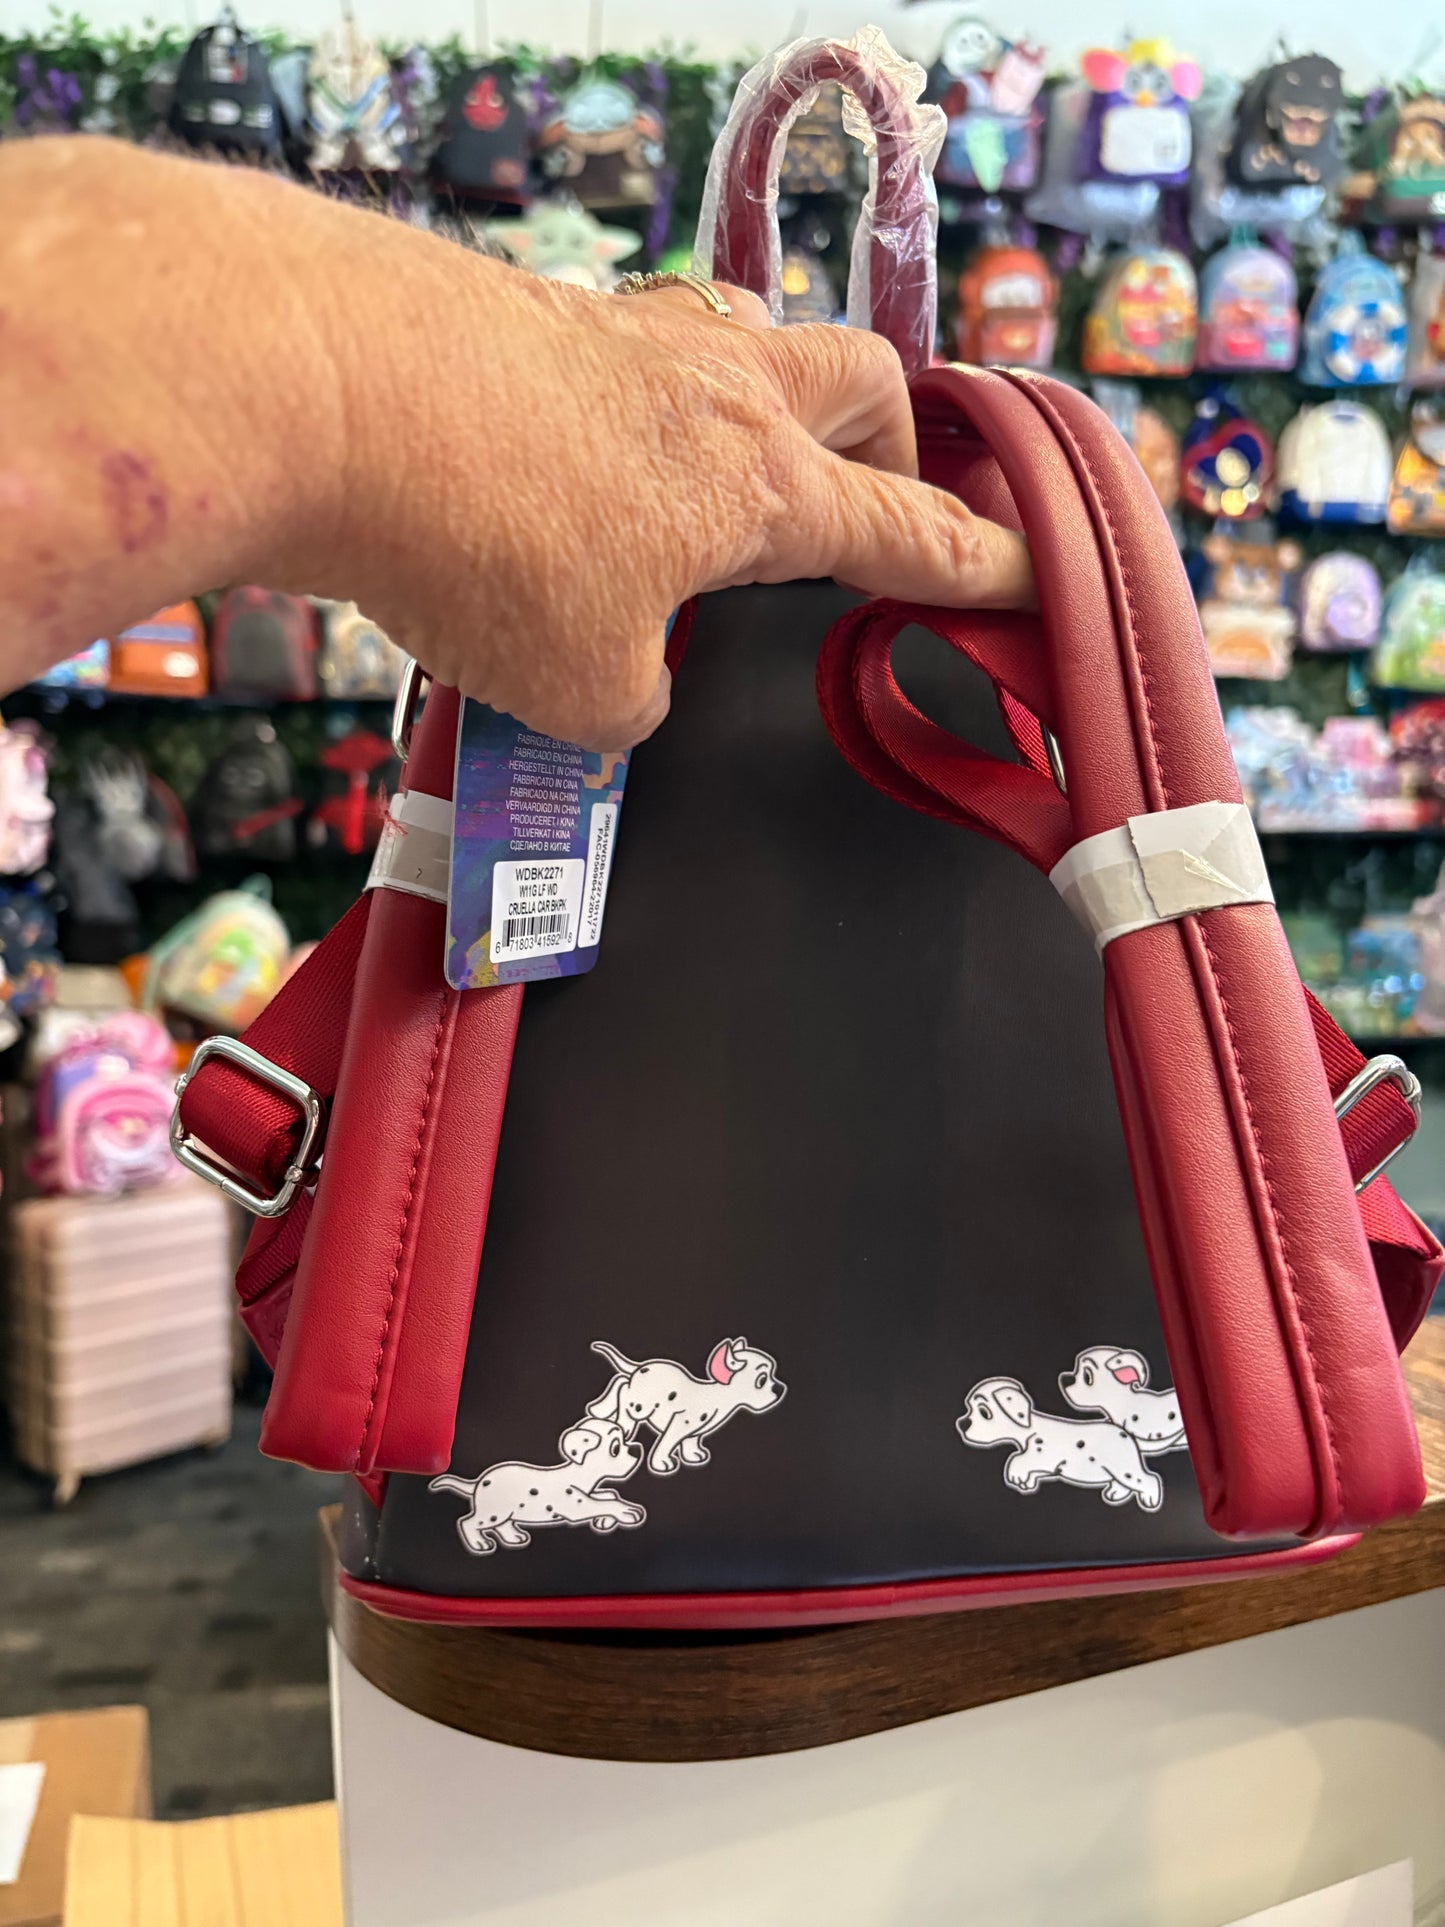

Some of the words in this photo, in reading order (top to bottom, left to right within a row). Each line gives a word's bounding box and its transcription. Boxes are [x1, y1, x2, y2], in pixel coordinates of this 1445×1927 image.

[518, 733, 550, 747] FABRIQUE
[552, 740, 560, 749] EN
[514, 747, 552, 760] FABRICADO
[553, 753, 562, 762] EN
[563, 754, 582, 764] CHINA
[509, 760, 555, 775] HERGESTELLT
[557, 766, 564, 775] IN
[565, 767, 583, 778] CHINA
[513, 774, 554, 788] FABBRICATO
[555, 778, 562, 788] IN
[563, 779, 578, 789] CINA
[510, 787, 548, 800] FABRICADO
[549, 791, 558, 800] NA
[559, 791, 579, 802] CHINA
[506, 800, 552, 813] VERVAARDIGD
[554, 803, 560, 814] IN
[562, 804, 581, 815] CHINA
[513, 827, 551, 838] TILLVERKAT
[555, 830, 570, 839] KINA
[510, 840, 543, 852] СДЕЛАНО
[544, 842, 548, 851] В
[550, 842, 570, 852] КИТАЕ
[516, 867, 563, 880] WDBK2271
[519, 885, 537, 897] W11G
[538, 884, 546, 896] LF
[547, 883, 558, 895] WD
[509, 902, 536, 915] CRUELLA
[538, 900, 550, 913] CAR
[551, 899, 567, 911] BKPK
[496, 942, 500, 953] 6
[510, 938, 534, 951] 71803
[537, 934, 560, 948] 41592
